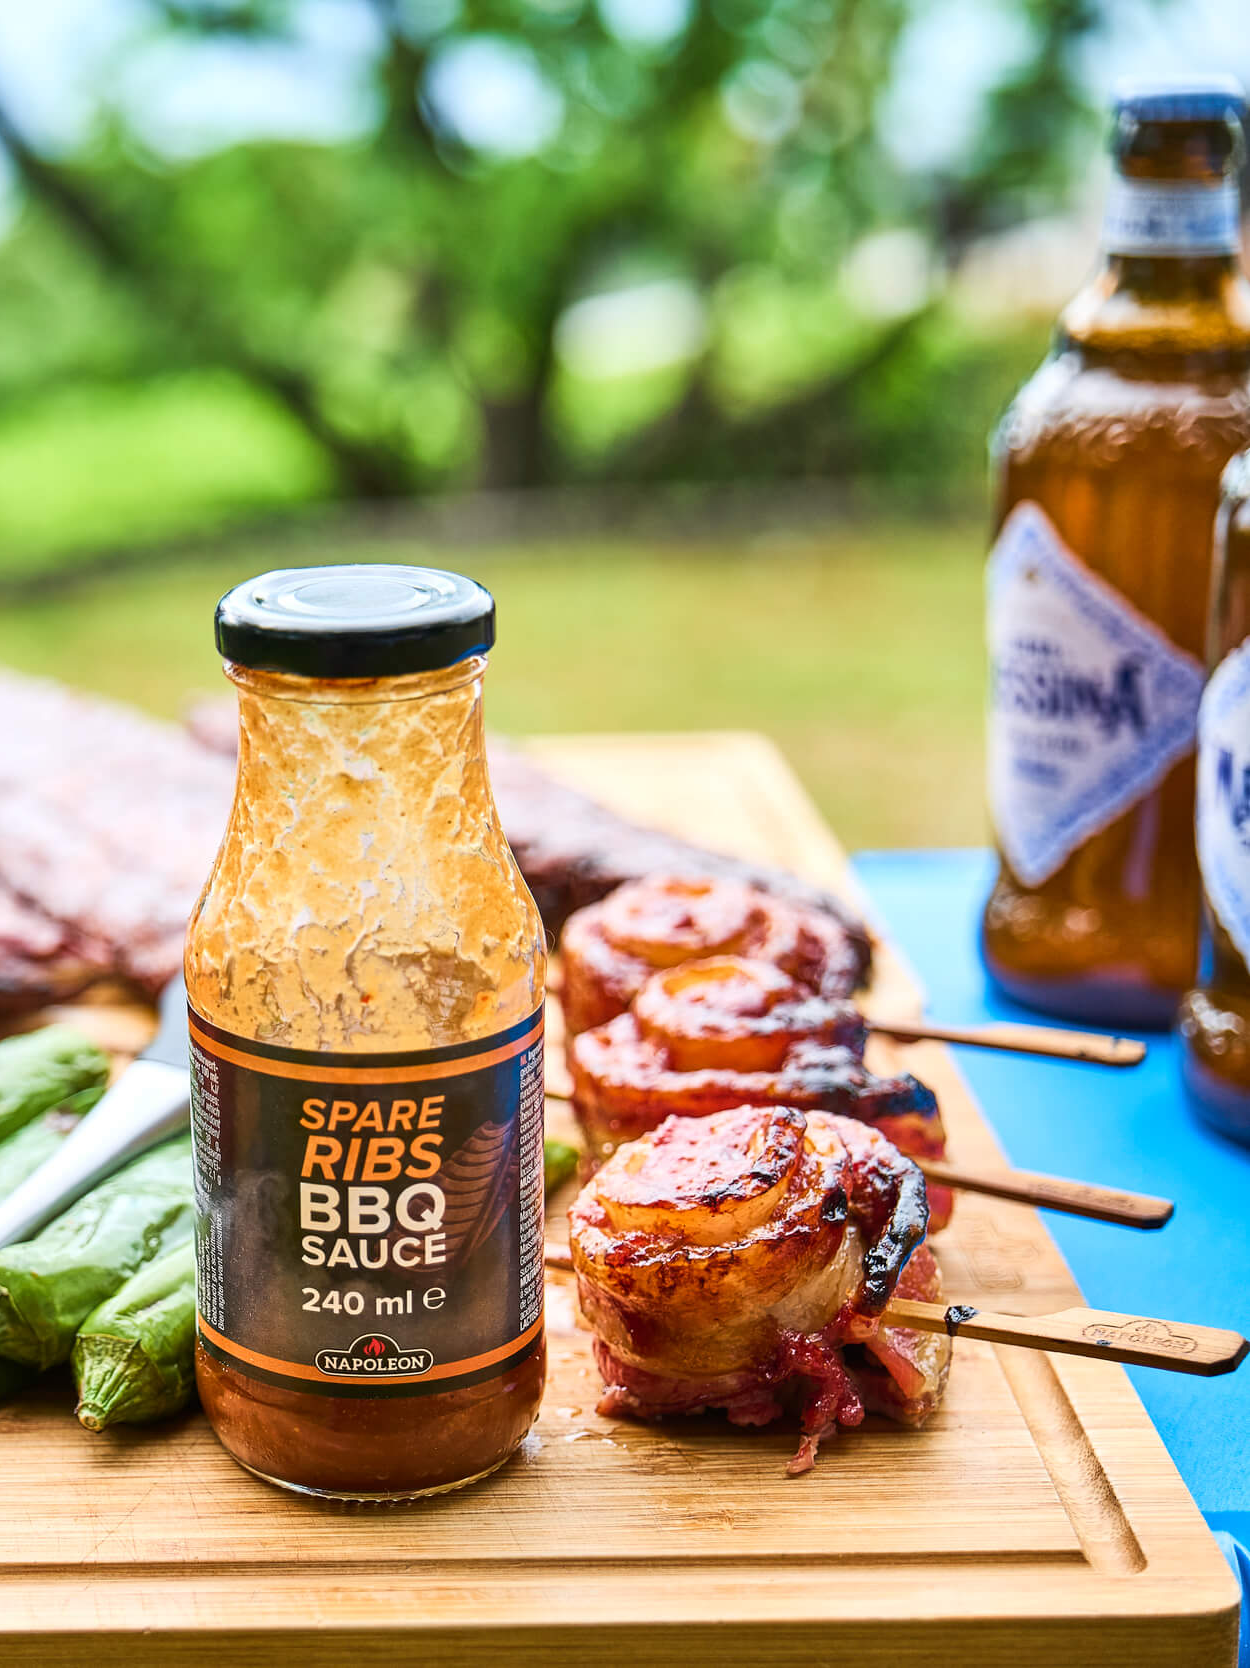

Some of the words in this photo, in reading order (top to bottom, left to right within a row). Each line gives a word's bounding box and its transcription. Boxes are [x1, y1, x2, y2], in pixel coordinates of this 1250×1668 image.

[300, 1095, 445, 1132] SPARE
[301, 1134, 444, 1182] RIBS
[300, 1182, 447, 1234] BBQ
[302, 1234, 447, 1269] SAUCE
[302, 1287, 365, 1315] 240
[375, 1288, 413, 1315] ml
[324, 1354, 425, 1373] NAPOLEON
